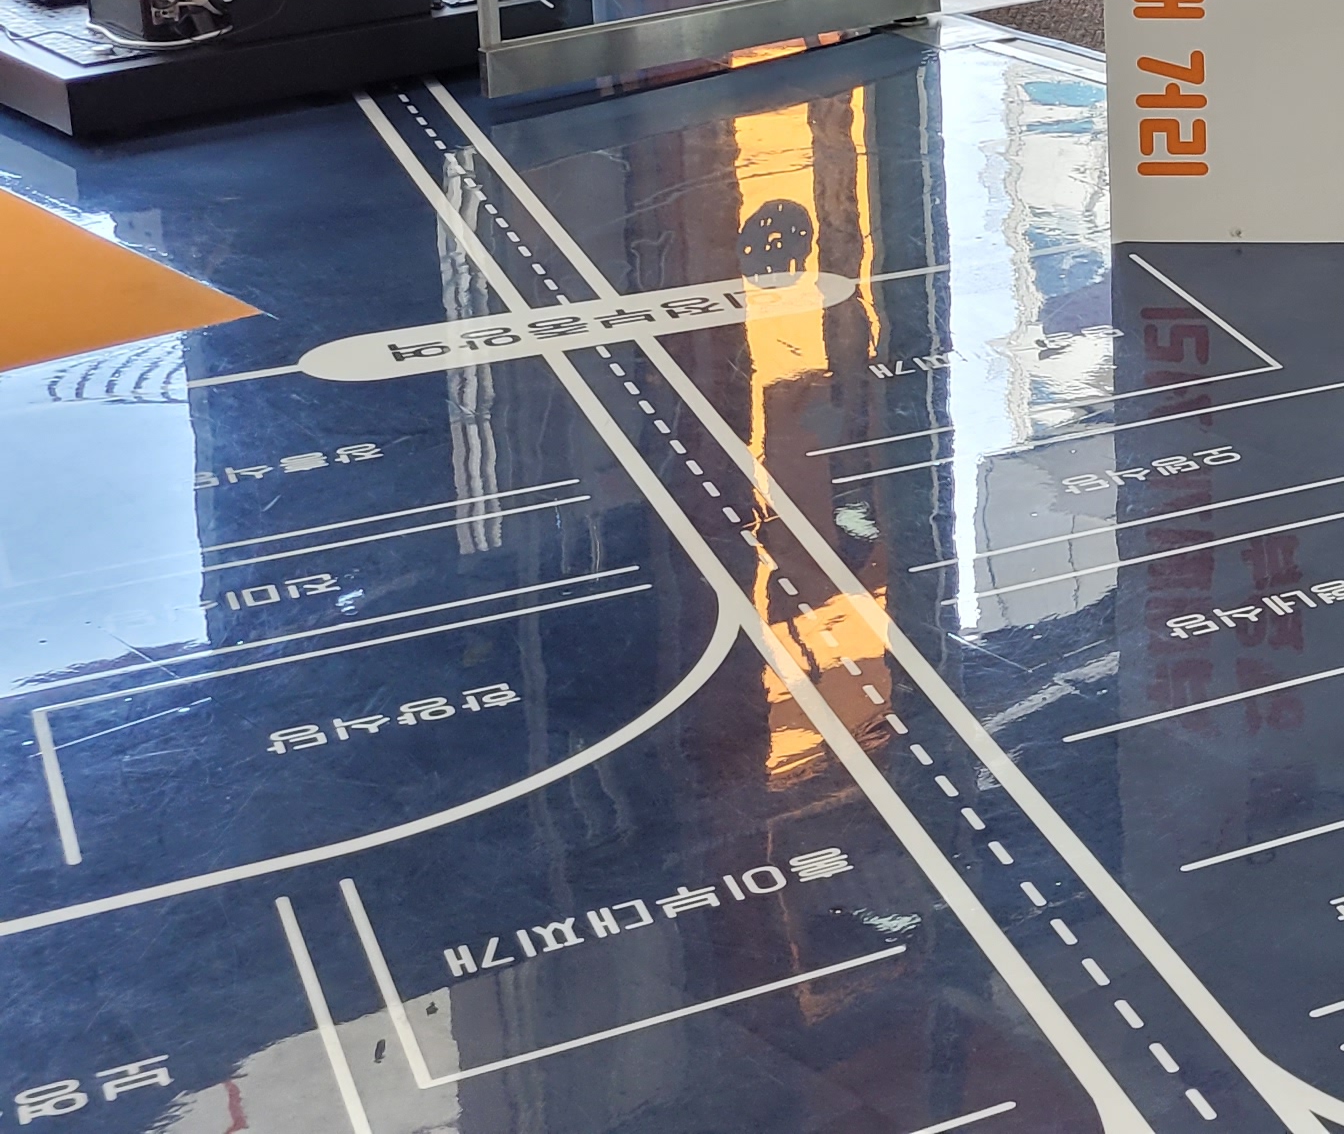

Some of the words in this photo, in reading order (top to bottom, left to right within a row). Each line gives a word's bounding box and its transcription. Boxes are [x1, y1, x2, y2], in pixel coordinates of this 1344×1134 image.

[1135, 49, 1209, 178] 거리
[1061, 444, 1242, 495] 오뎅식당
[266, 680, 521, 756] 한양식당
